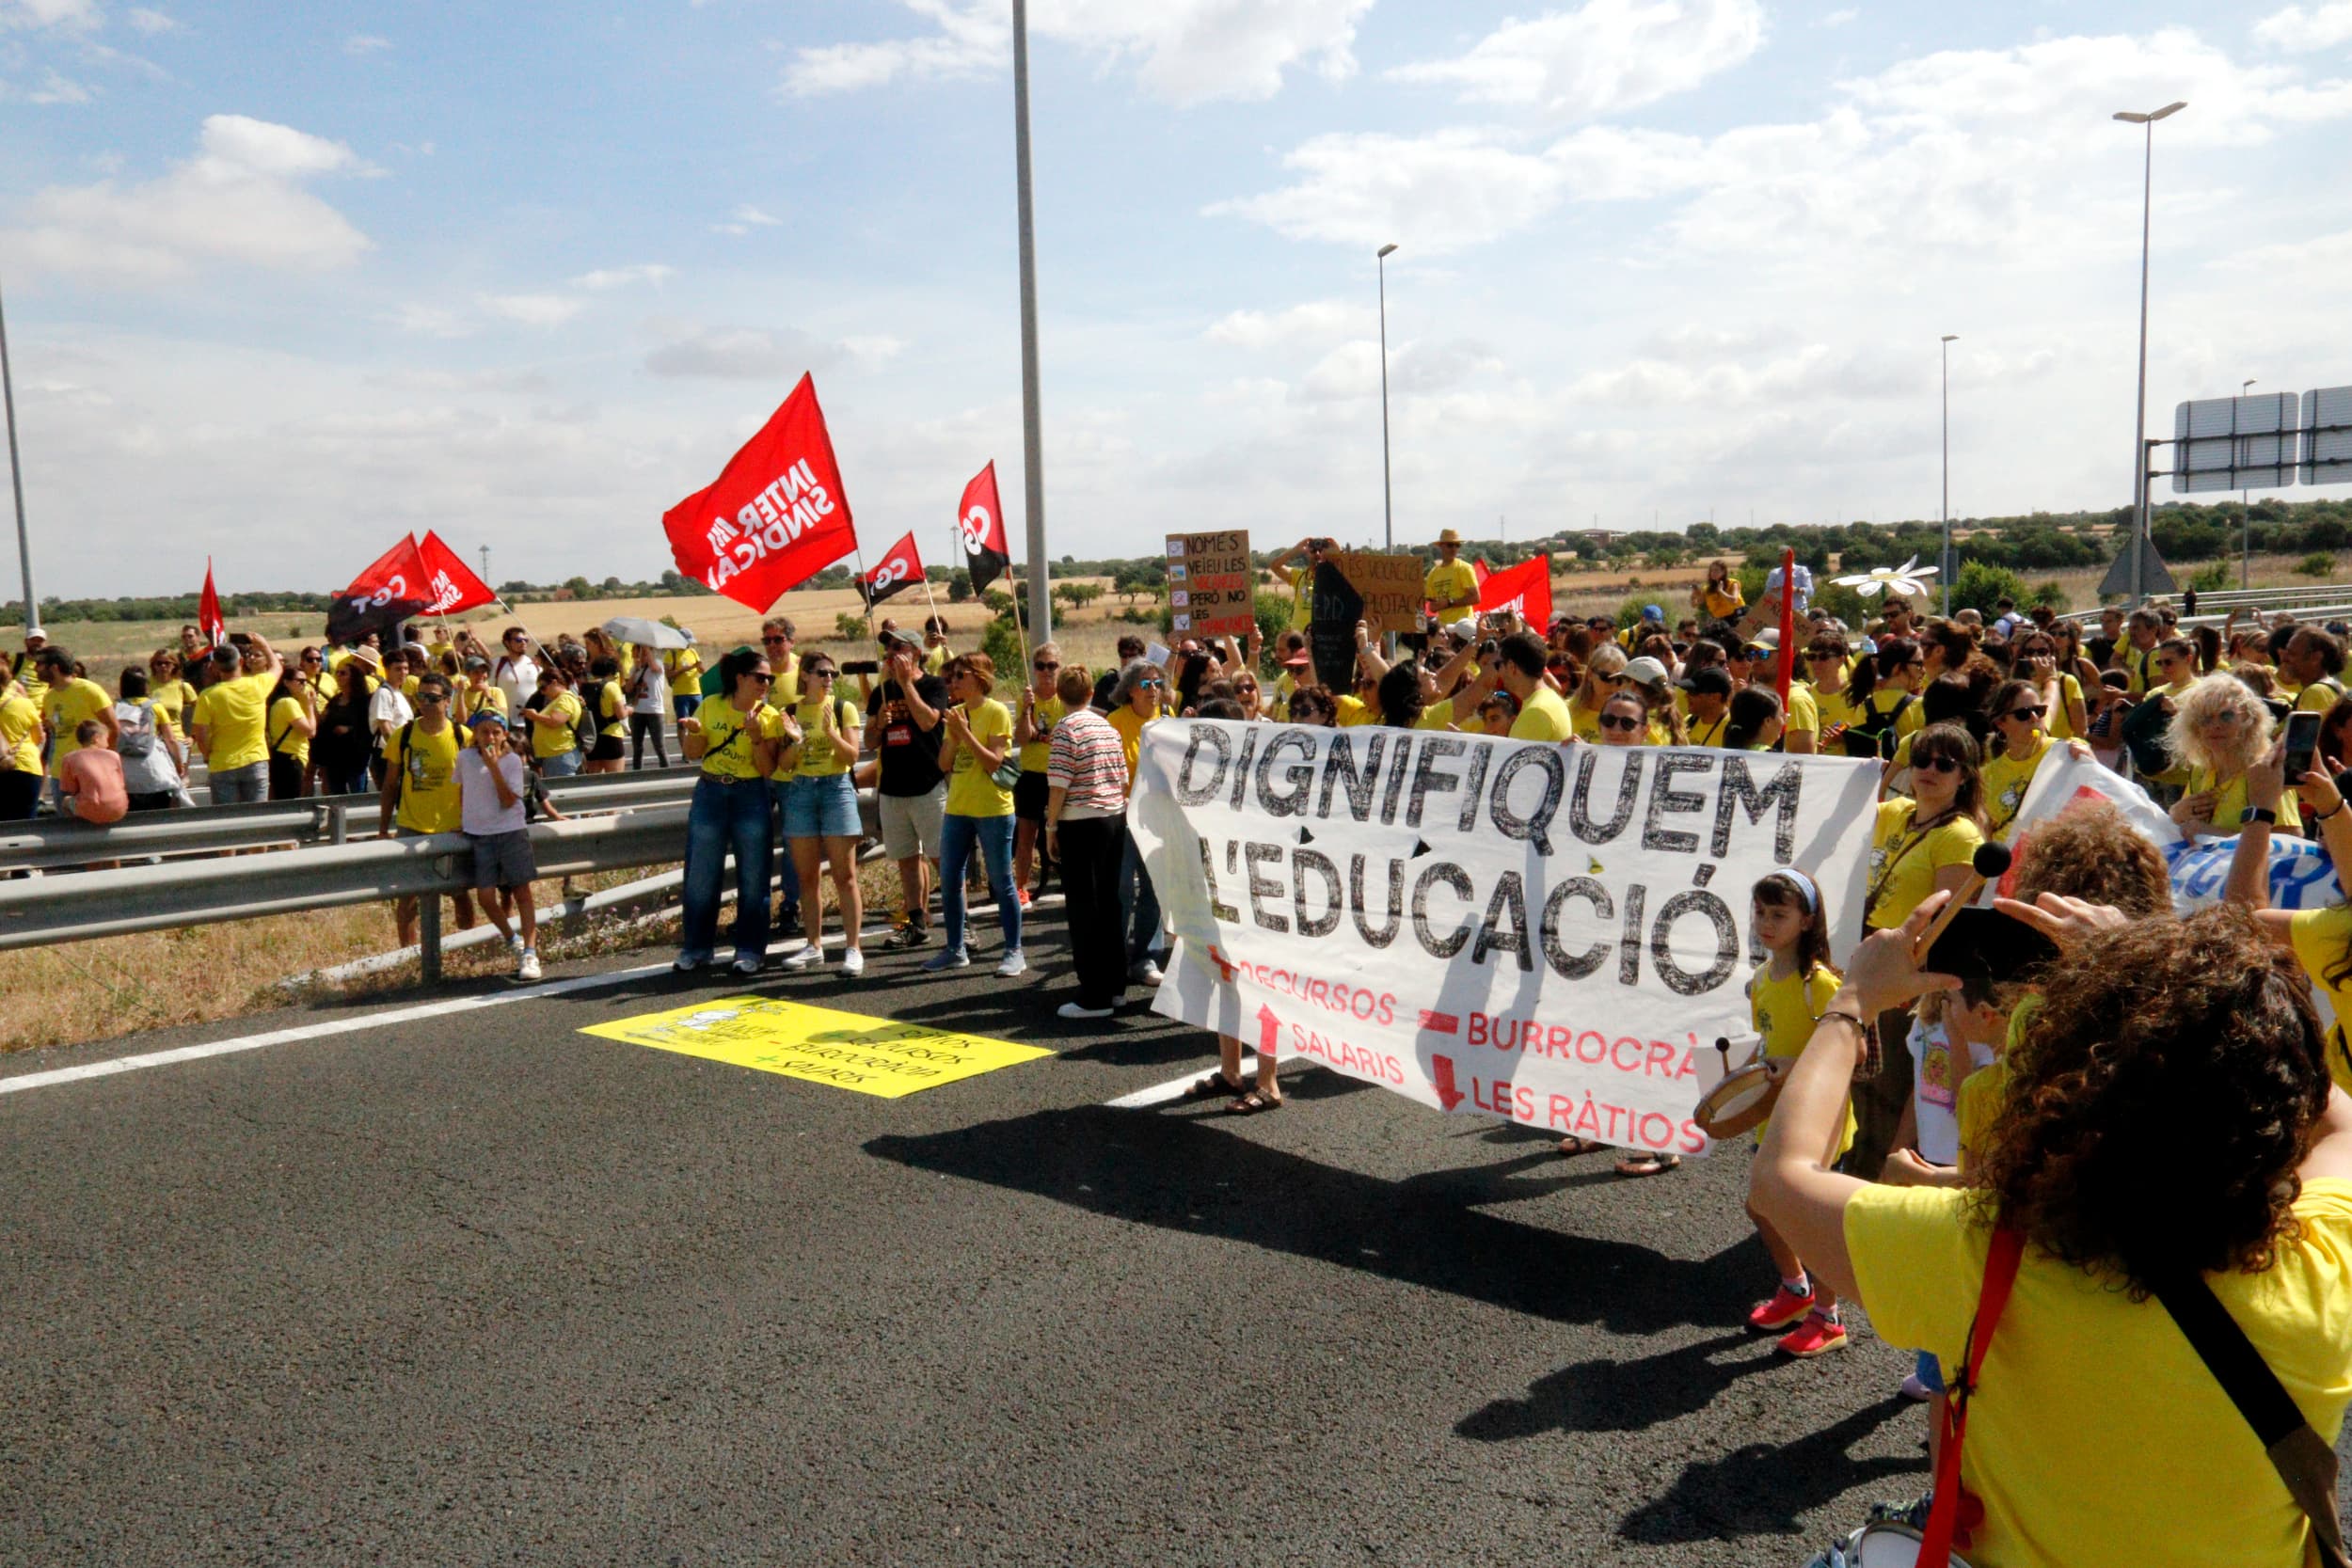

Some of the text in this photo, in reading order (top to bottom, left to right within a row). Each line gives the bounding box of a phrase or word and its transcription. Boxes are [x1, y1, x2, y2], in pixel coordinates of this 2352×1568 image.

[1225, 556, 1247, 573] LES
[1190, 589, 1246, 606] PERÒ NO
[1191, 610, 1210, 620] LES
[1175, 723, 1804, 864] DIGNIFIQUEM
[1293, 1022, 1404, 1085] SALARIS
[773, 1060, 880, 1084] SALARIS
[1472, 1077, 1706, 1154] LES RÀTIOS
